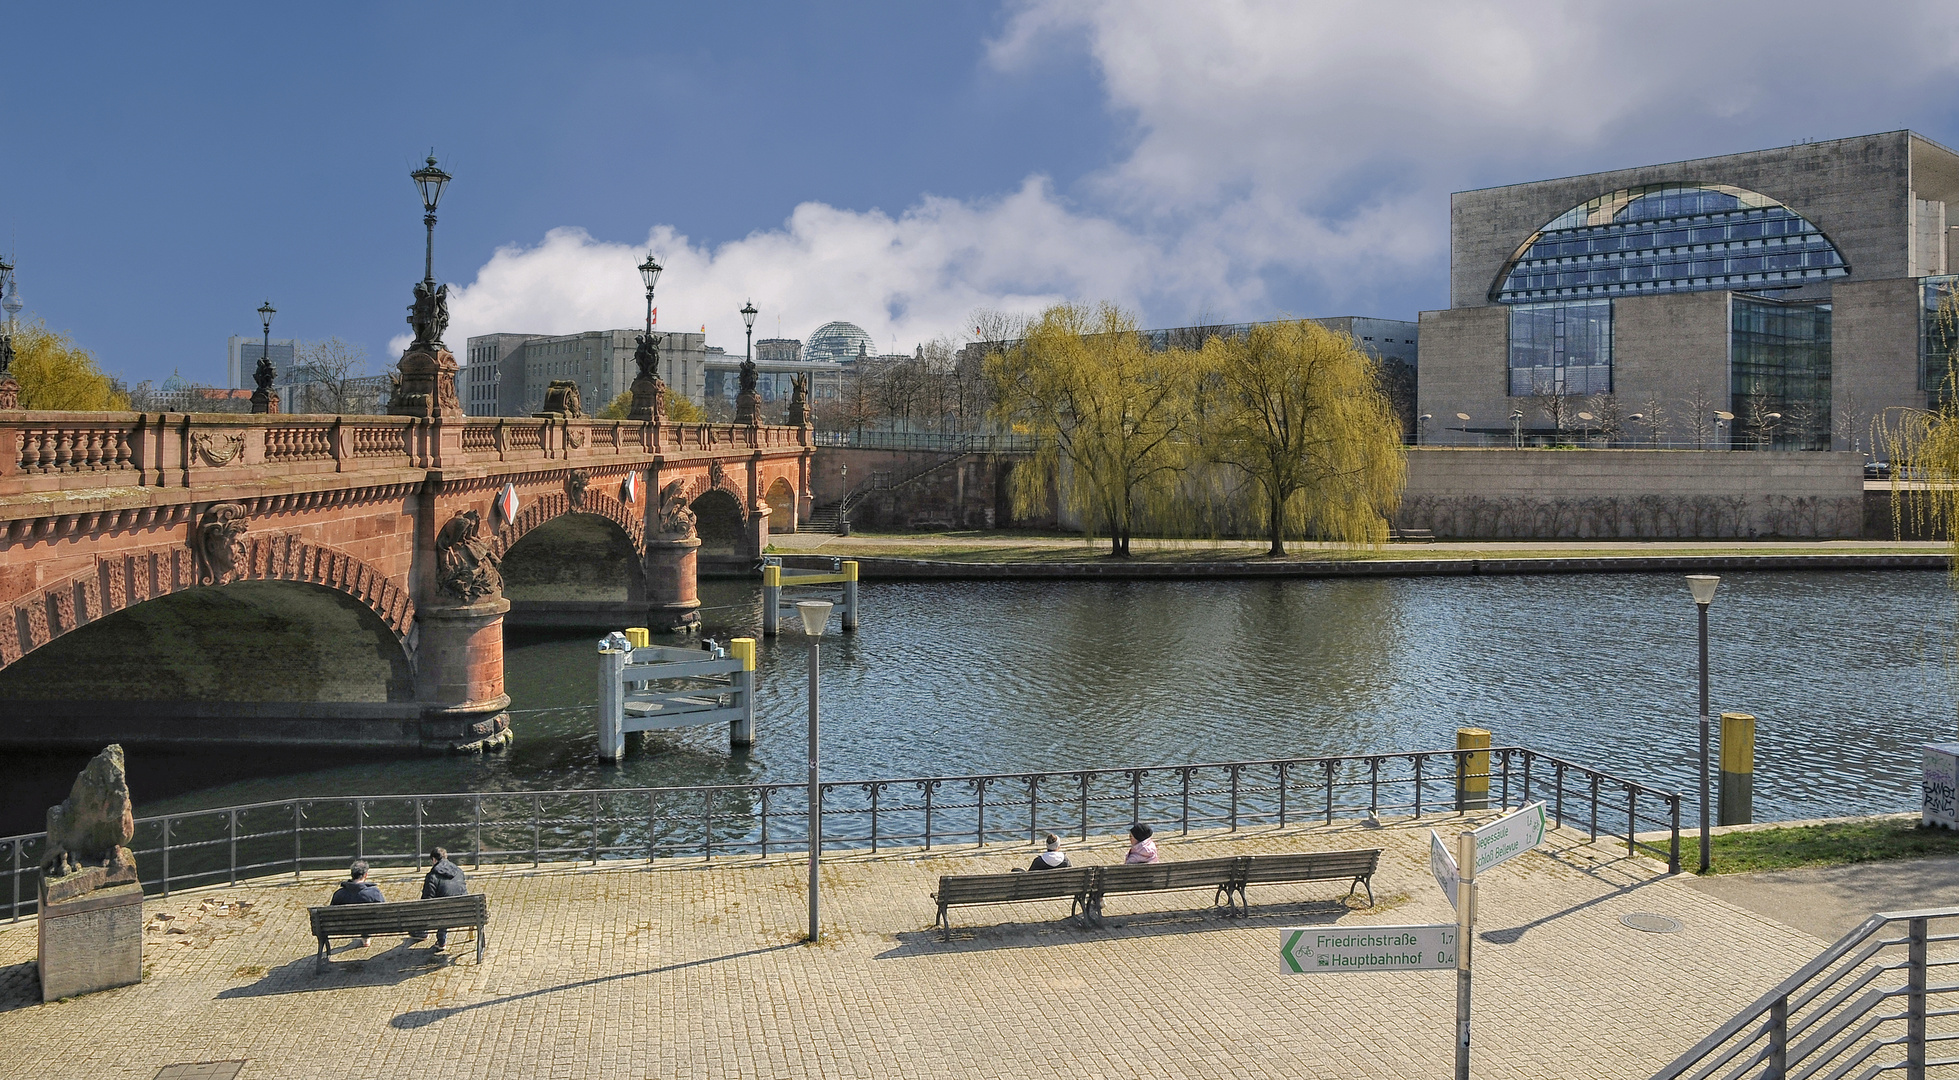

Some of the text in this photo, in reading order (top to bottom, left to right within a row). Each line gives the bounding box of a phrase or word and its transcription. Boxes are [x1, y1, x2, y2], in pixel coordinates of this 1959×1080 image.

[1495, 841, 1519, 859] Bellevue
[1317, 933, 1417, 948] Friedrichstraße
[1332, 952, 1422, 968] Hauptbahnhof
